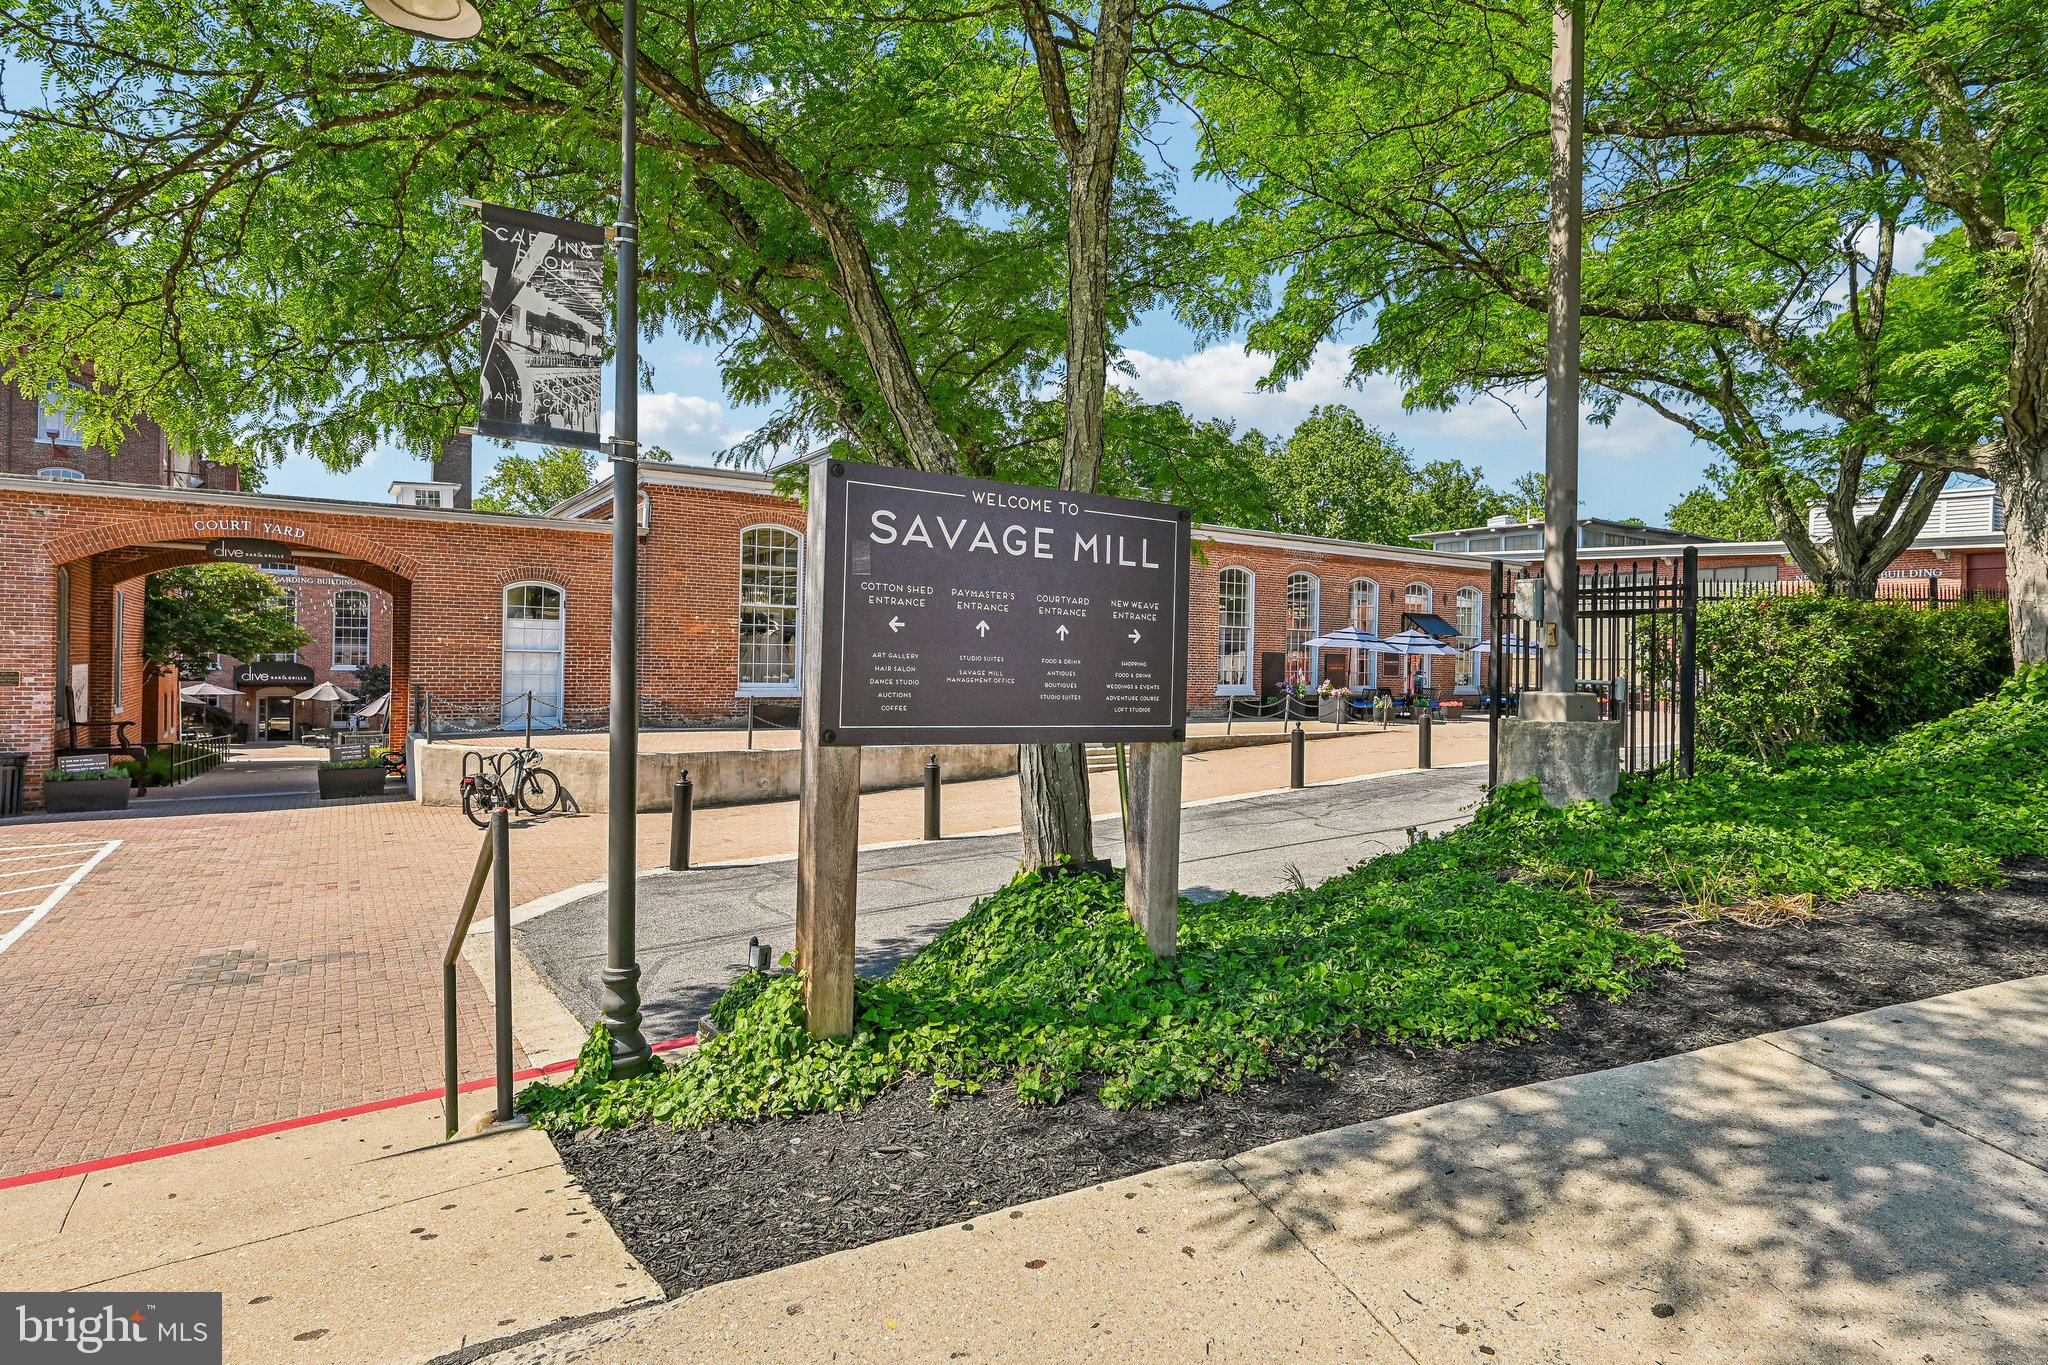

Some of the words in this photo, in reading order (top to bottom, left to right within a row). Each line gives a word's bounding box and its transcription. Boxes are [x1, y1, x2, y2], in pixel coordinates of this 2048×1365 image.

[517, 248, 574, 272] ROM
[972, 491, 1051, 512] WELCOME
[1059, 502, 1078, 515] TO
[194, 520, 250, 530] COURT
[263, 523, 305, 538] YARD
[870, 510, 1053, 559] SAVAGE
[1074, 532, 1158, 568] MILL
[214, 540, 243, 557] dive
[1879, 568, 1943, 579] BUILDING
[317, 578, 356, 586] BUILDING
[861, 582, 903, 592] COTTON
[907, 585, 933, 594] SHED
[952, 589, 1014, 600] PAYMASTER'S
[1037, 595, 1089, 605] COURTYARD
[869, 596, 925, 607] ENTRANCE
[957, 602, 1009, 612] ENTRANCE
[1131, 602, 1158, 610] WEAVE
[1039, 607, 1086, 617] ENTRANCE
[1113, 612, 1156, 621] ENTRANCE
[241, 666, 269, 681] dive
